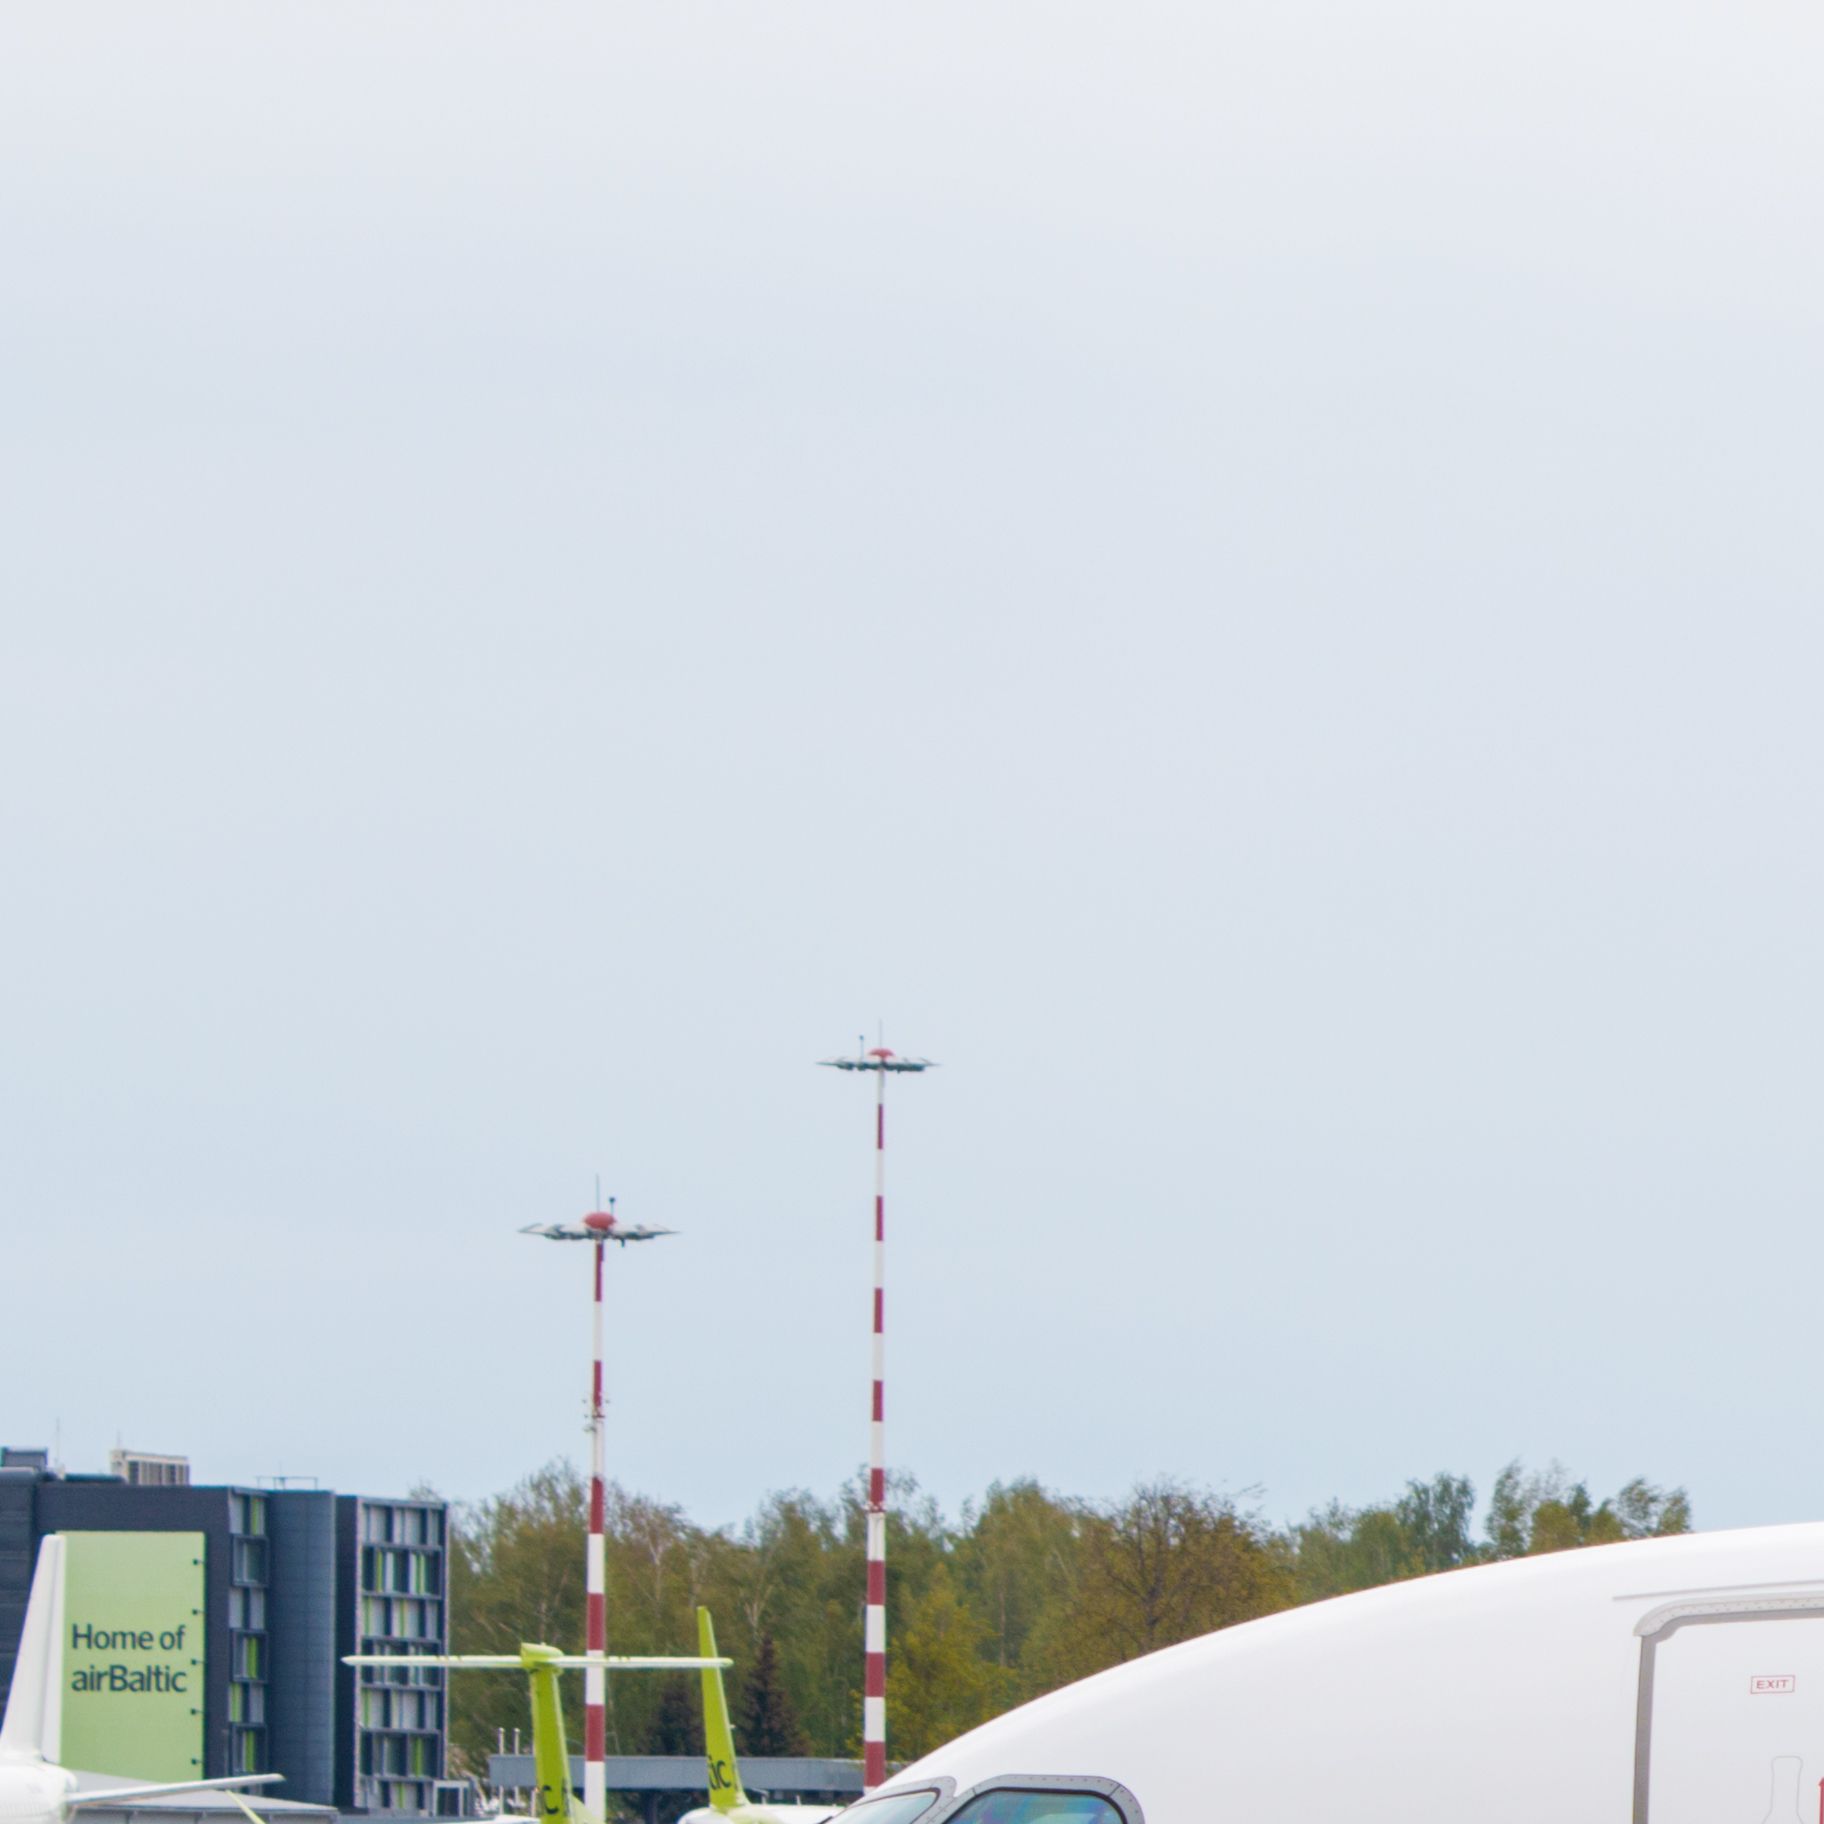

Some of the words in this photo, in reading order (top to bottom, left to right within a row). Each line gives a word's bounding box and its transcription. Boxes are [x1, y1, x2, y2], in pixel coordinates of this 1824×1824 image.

[72, 1624, 155, 1650] Home
[159, 1624, 186, 1650] of
[71, 1664, 187, 1693] airBaltic
[1756, 1679, 1789, 1690] EXIT
